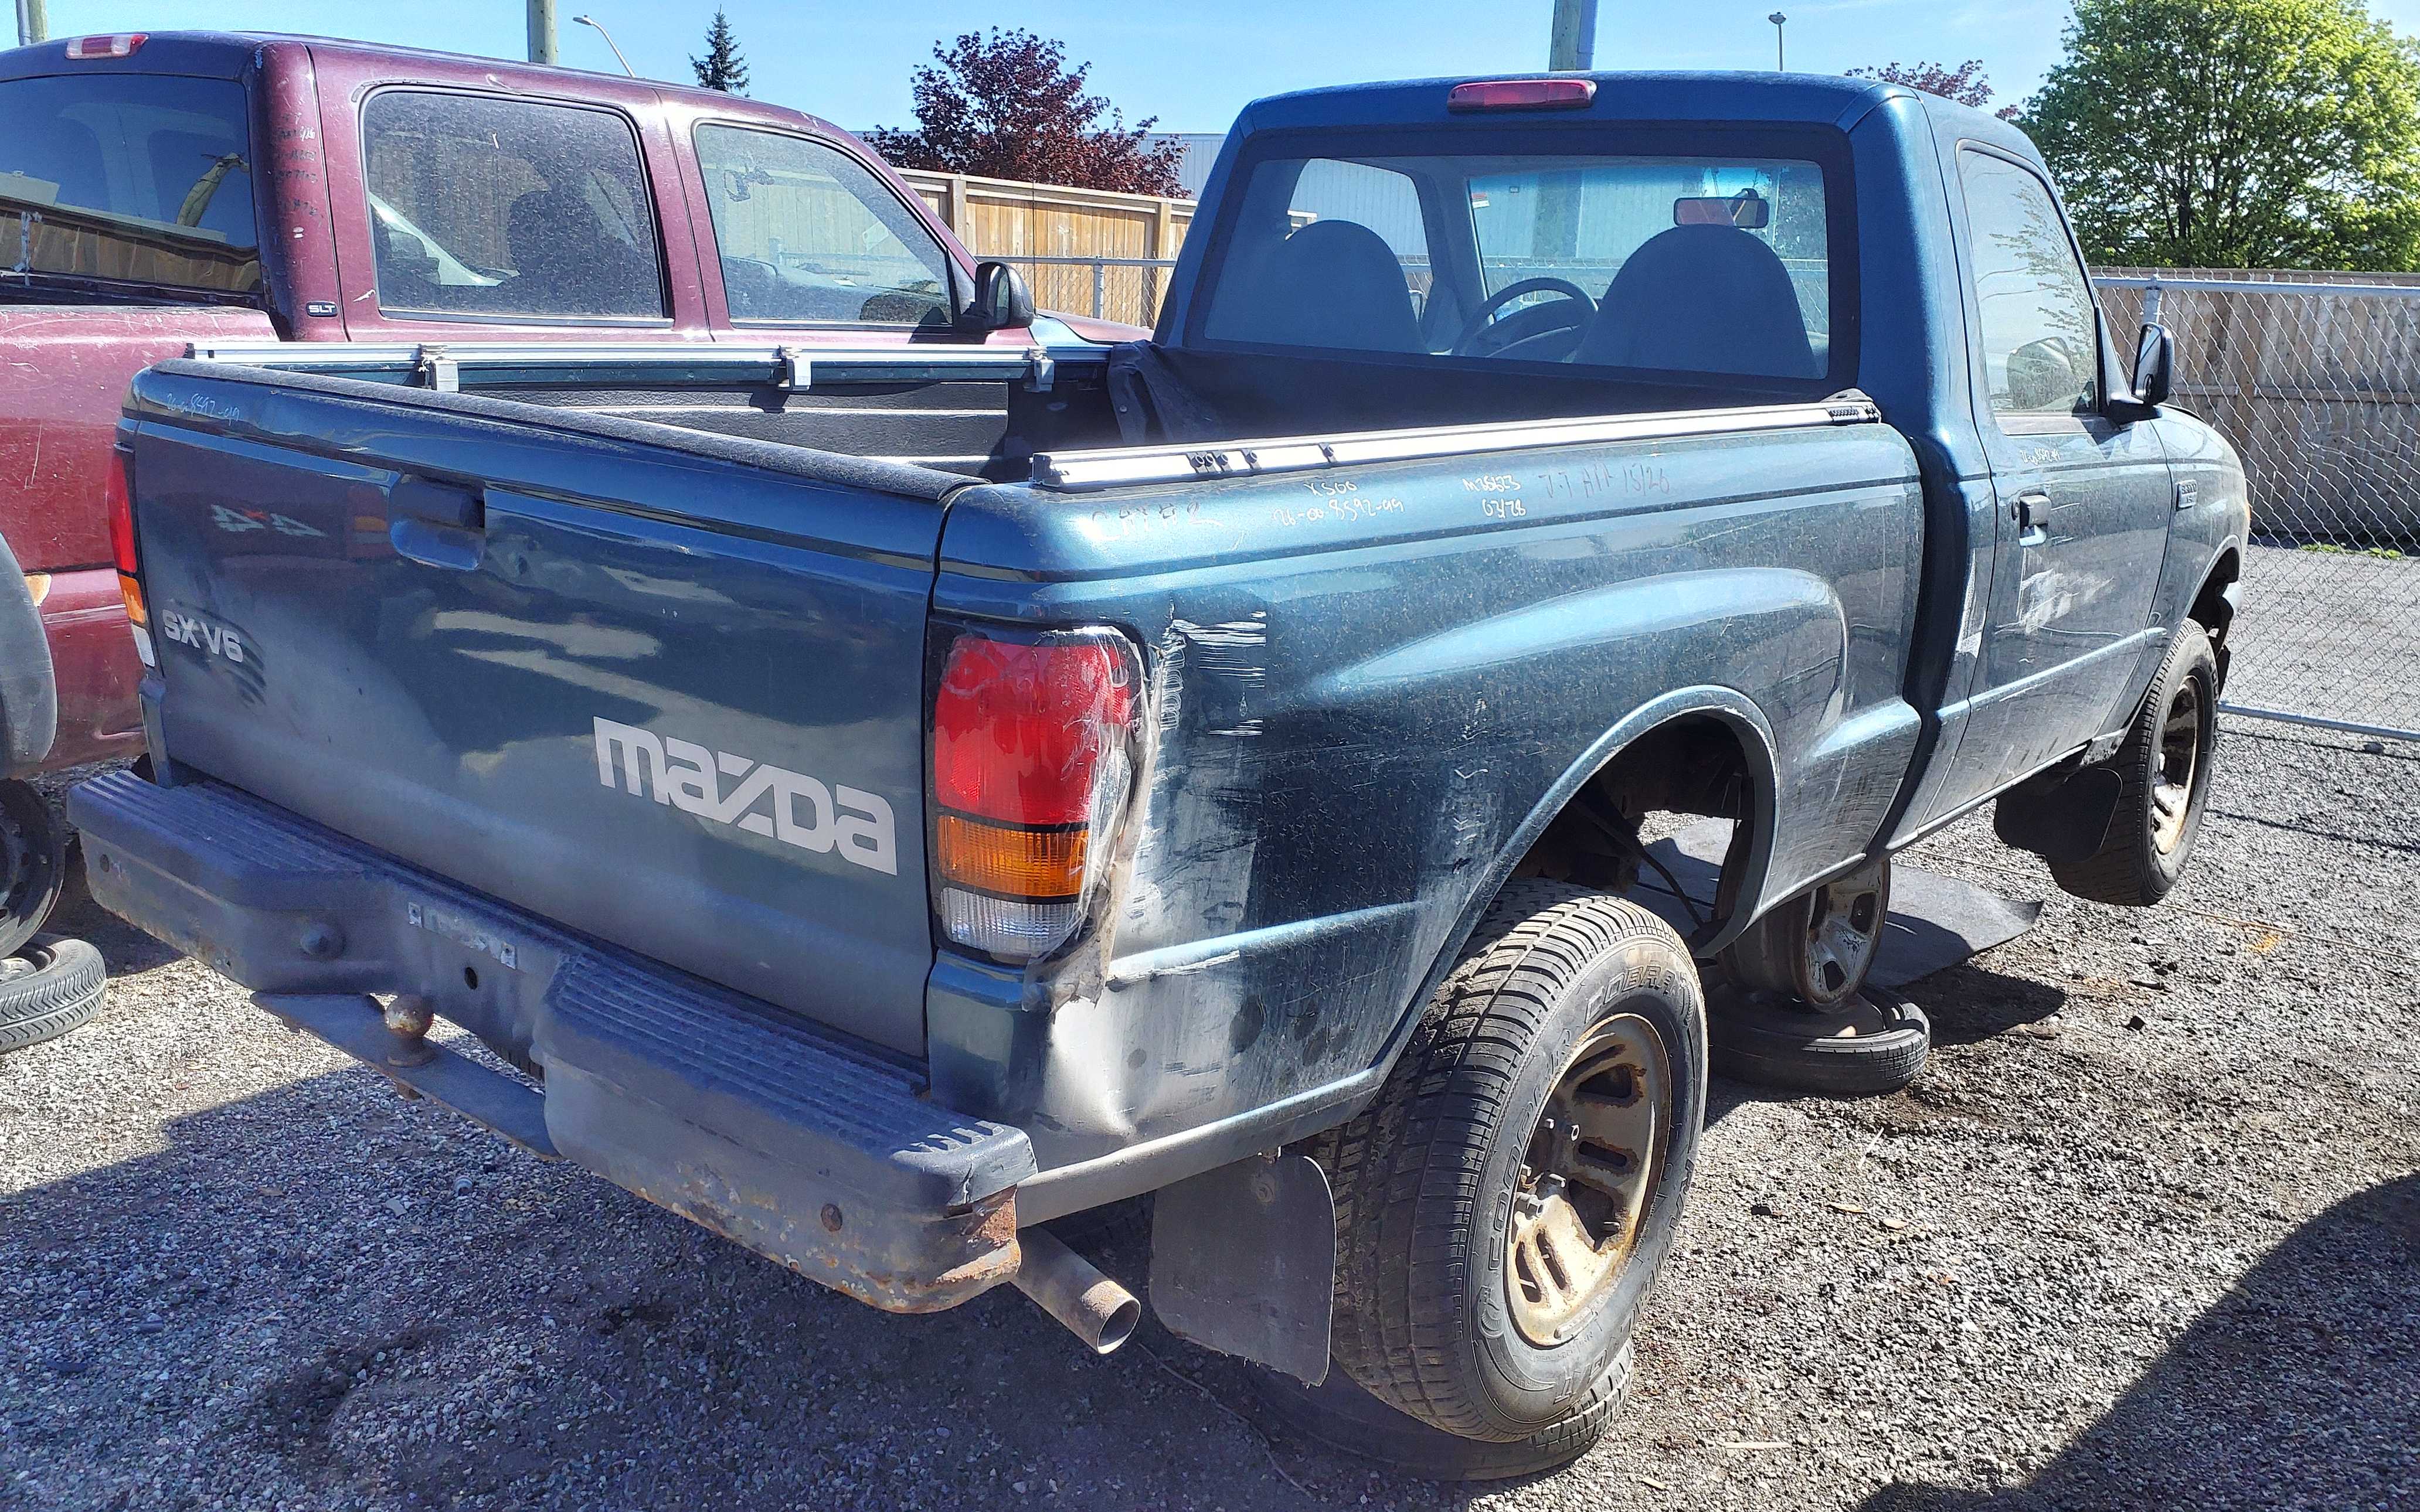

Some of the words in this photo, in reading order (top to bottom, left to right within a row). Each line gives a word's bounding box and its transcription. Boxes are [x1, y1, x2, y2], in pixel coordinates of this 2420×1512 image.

[308, 305, 335, 313] SLT
[162, 609, 200, 649] SX
[200, 620, 244, 663] V6
[1584, 965, 1676, 1026] COBRA
